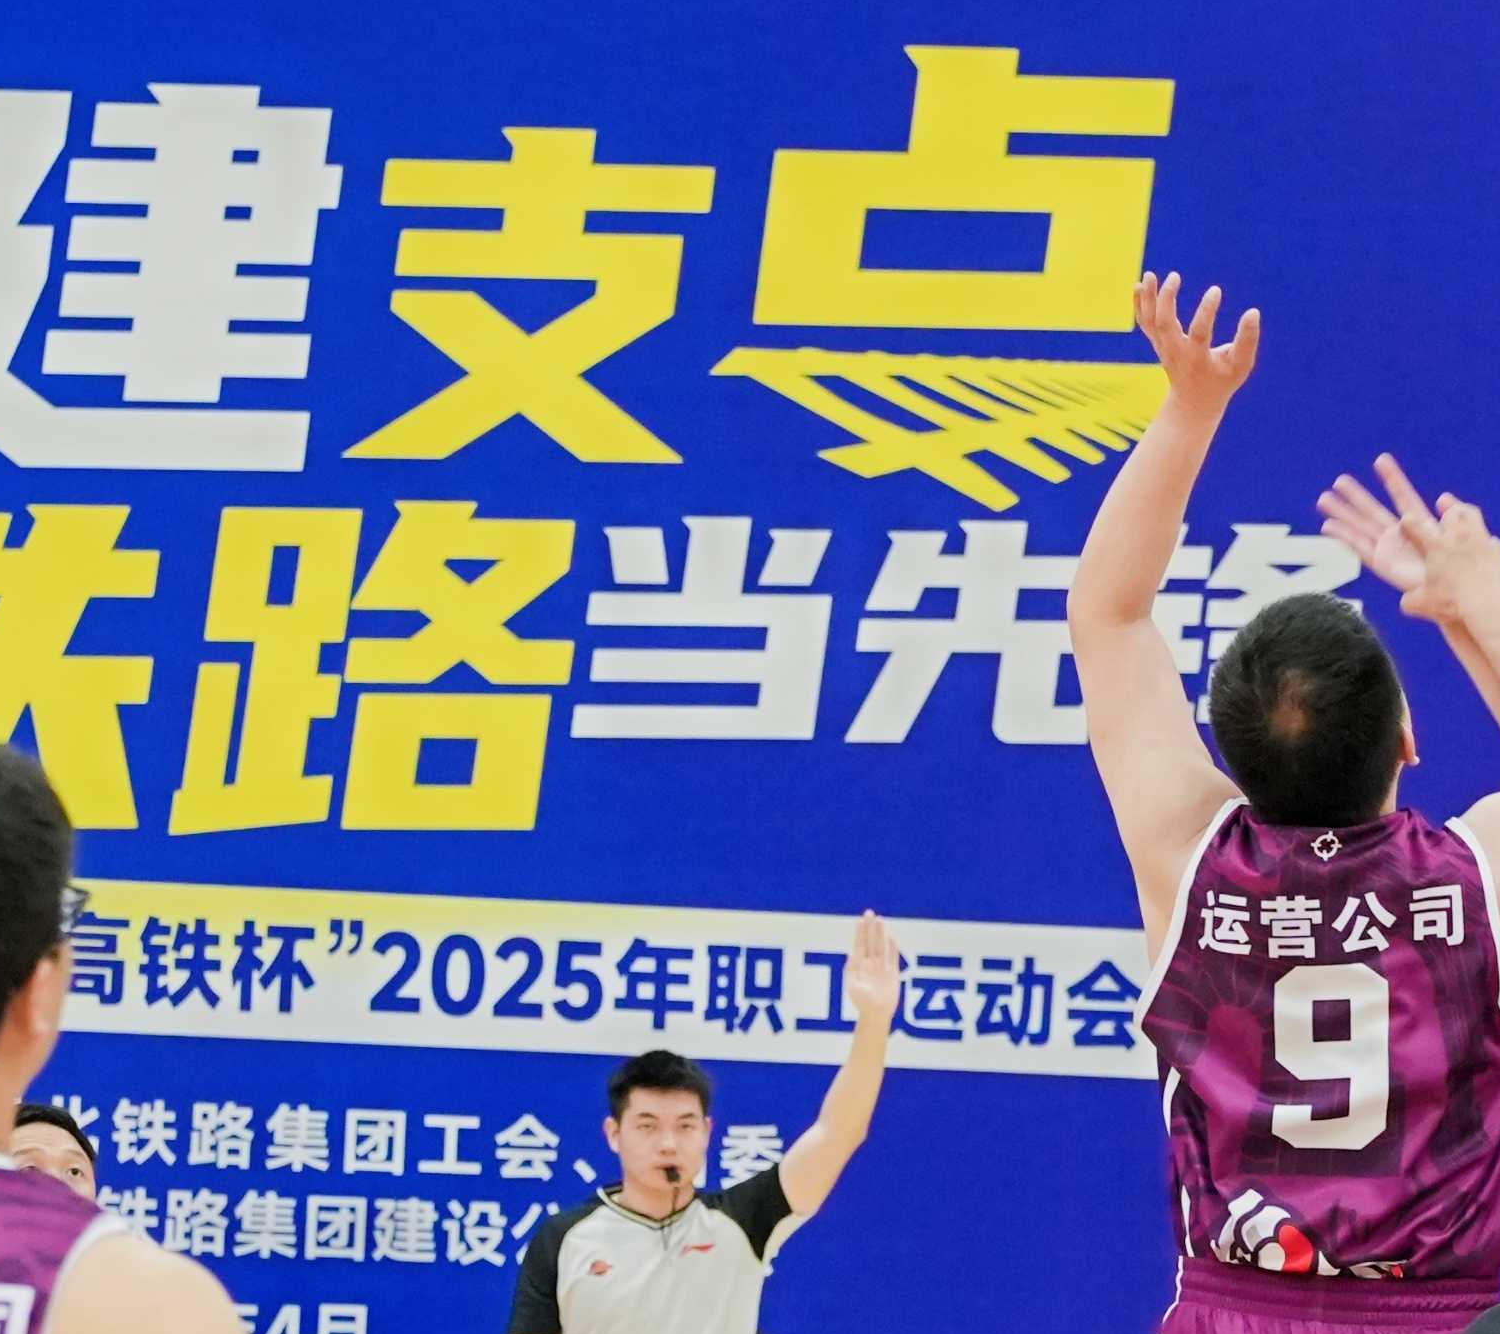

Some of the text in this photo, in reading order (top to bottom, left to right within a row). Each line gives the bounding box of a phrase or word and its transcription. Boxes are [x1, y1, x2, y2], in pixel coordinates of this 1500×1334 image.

[1197, 883, 1467, 960] 运营公司
[1271, 962, 1390, 1151] 9
